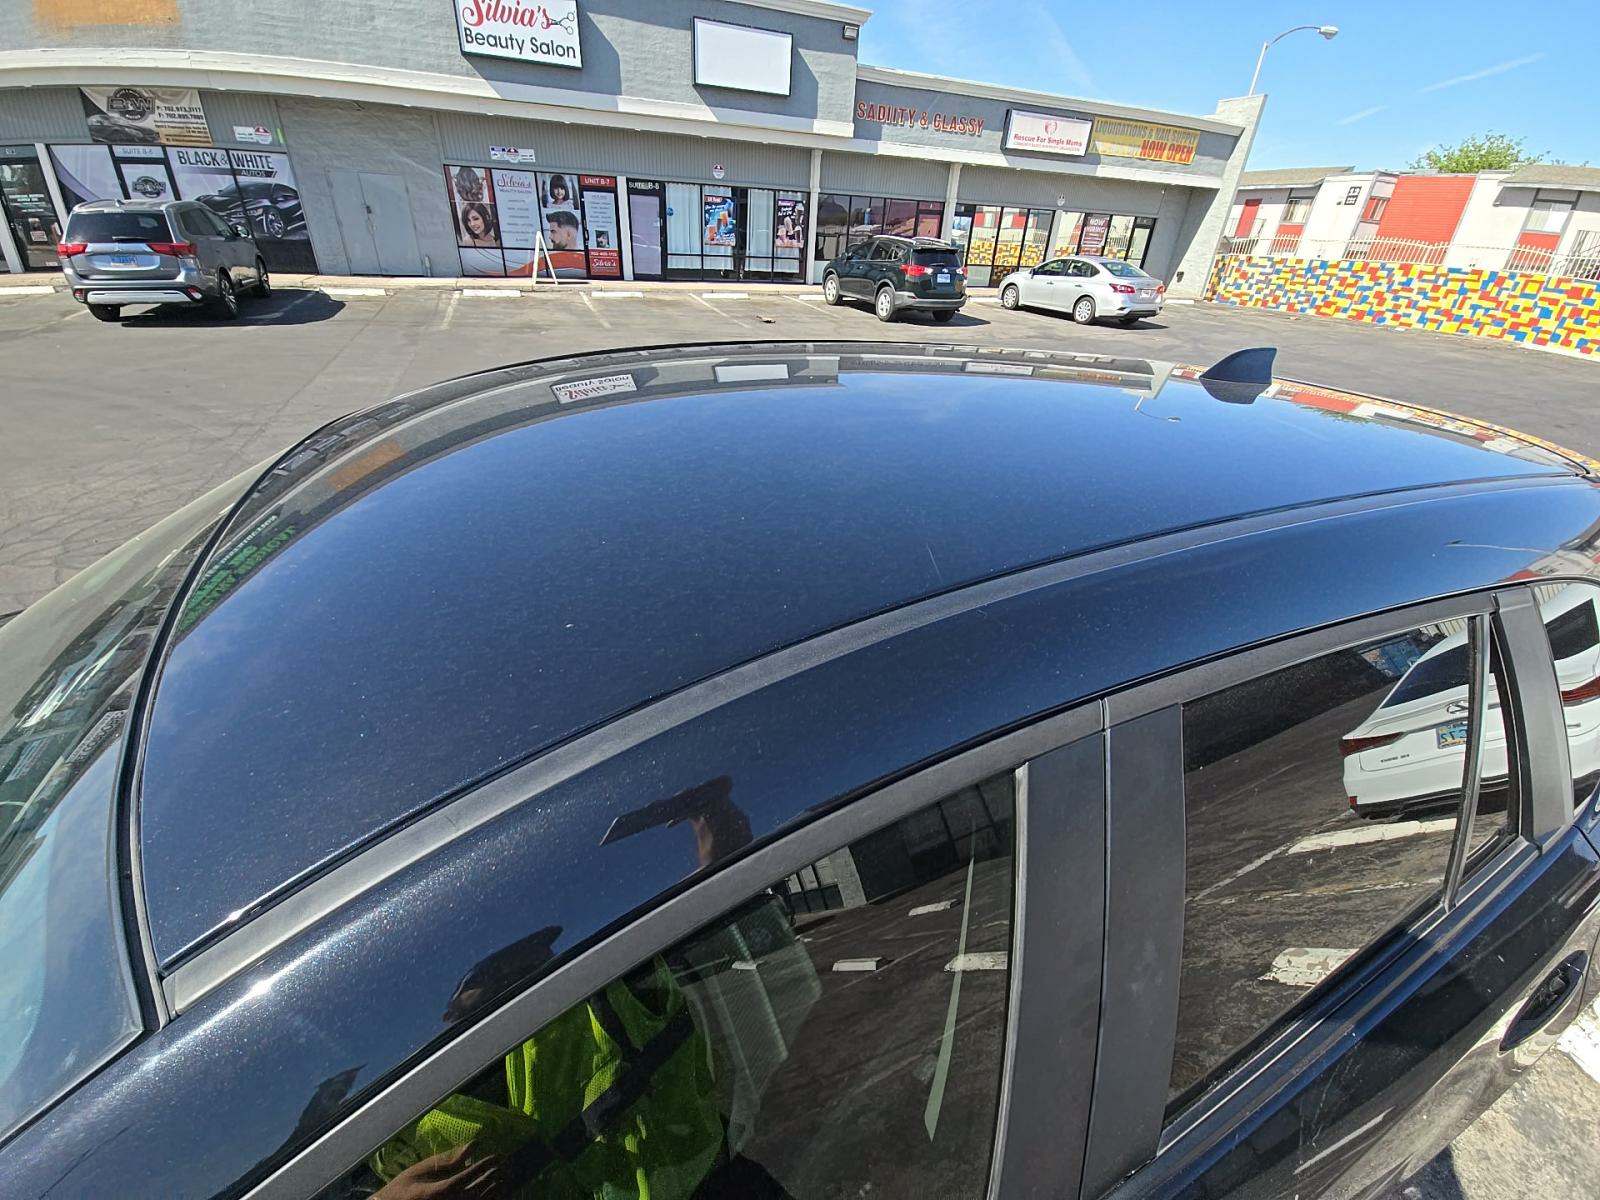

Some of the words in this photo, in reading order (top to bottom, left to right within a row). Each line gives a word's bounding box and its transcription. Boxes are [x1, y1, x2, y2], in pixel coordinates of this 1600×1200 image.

[464, 27, 525, 54] Beauty
[530, 36, 576, 59] Salon
[919, 111, 928, 128] &
[933, 113, 984, 136] CLASSY
[1047, 136, 1065, 145] Single
[1066, 139, 1082, 147] Moms
[1140, 139, 1168, 159] NOW
[1168, 142, 1194, 163] OPEN
[176, 150, 222, 167] BLACK
[221, 155, 230, 166] &
[232, 152, 275, 170] WHITE
[1089, 218, 1106, 226] NOW
